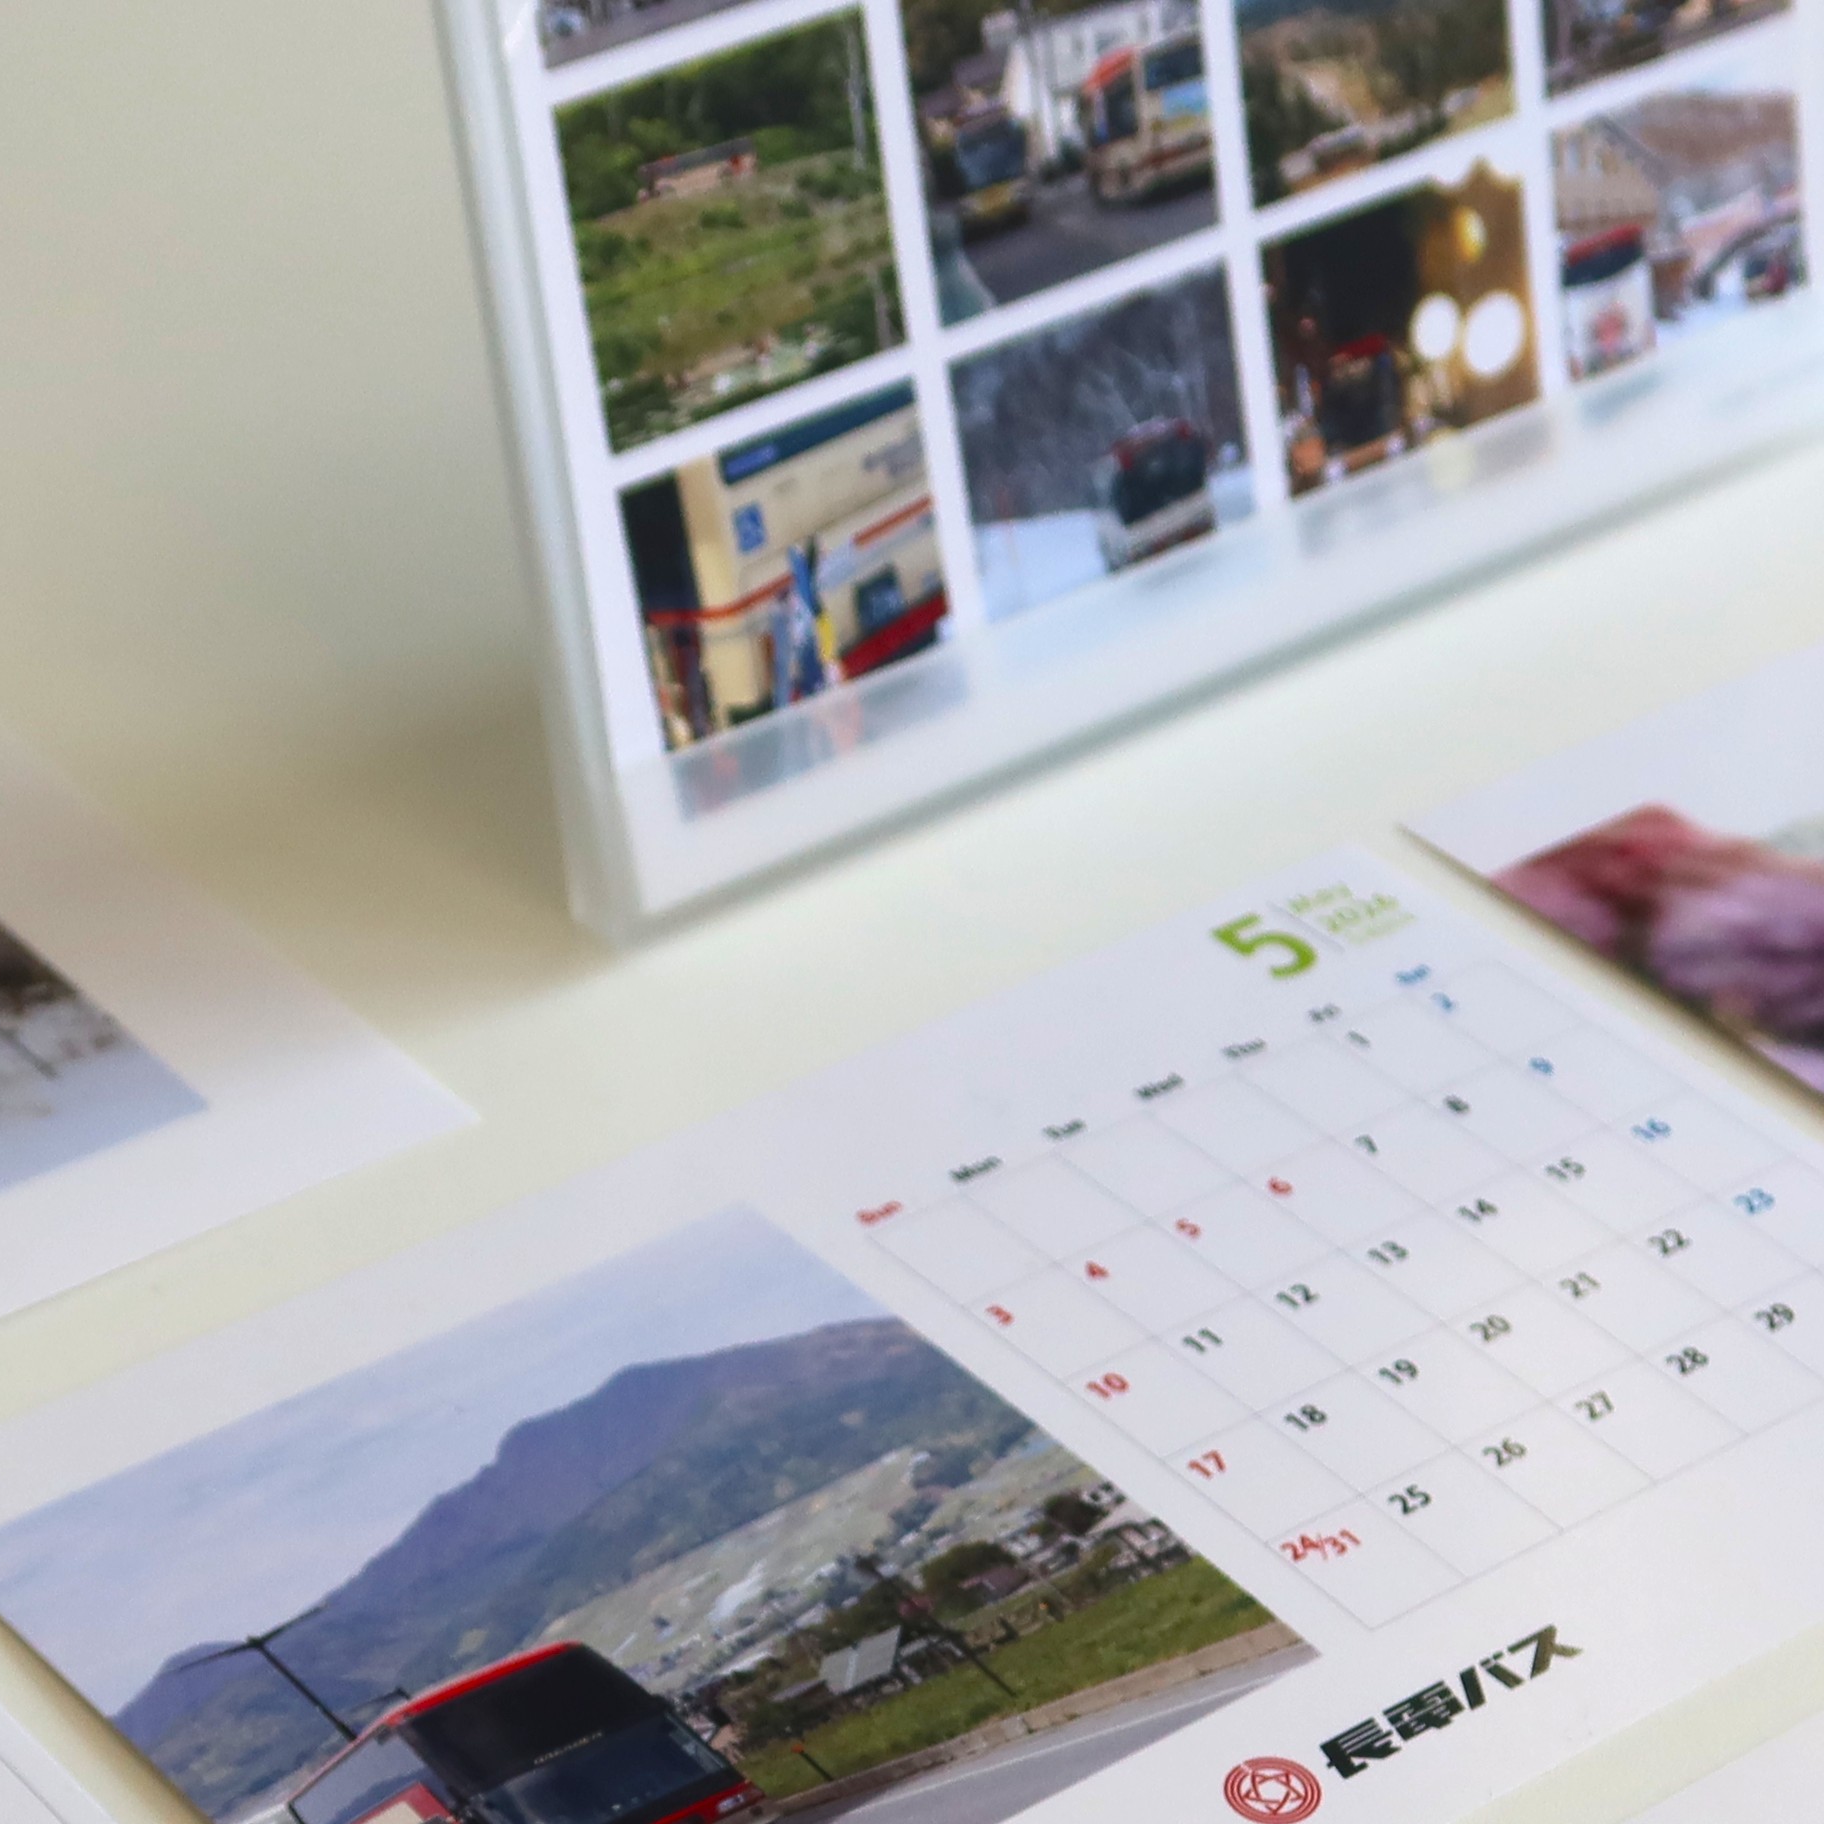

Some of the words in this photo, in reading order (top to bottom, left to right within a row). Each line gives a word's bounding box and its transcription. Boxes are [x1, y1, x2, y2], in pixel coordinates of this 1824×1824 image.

[1213, 915, 1317, 978] 5
[1086, 1373, 1130, 1399] 10
[1182, 1328, 1223, 1354] 11
[1275, 1283, 1319, 1310] 12
[1188, 1450, 1226, 1479] 17
[1284, 1404, 1328, 1431] 18
[1378, 1359, 1419, 1385] 19
[1388, 1485, 1432, 1516] 25
[1482, 1438, 1527, 1468] 26
[1575, 1391, 1615, 1422] 27
[1665, 1347, 1709, 1376] 28
[1755, 1303, 1795, 1333] 29
[1320, 1626, 1580, 1779] 長電バス
